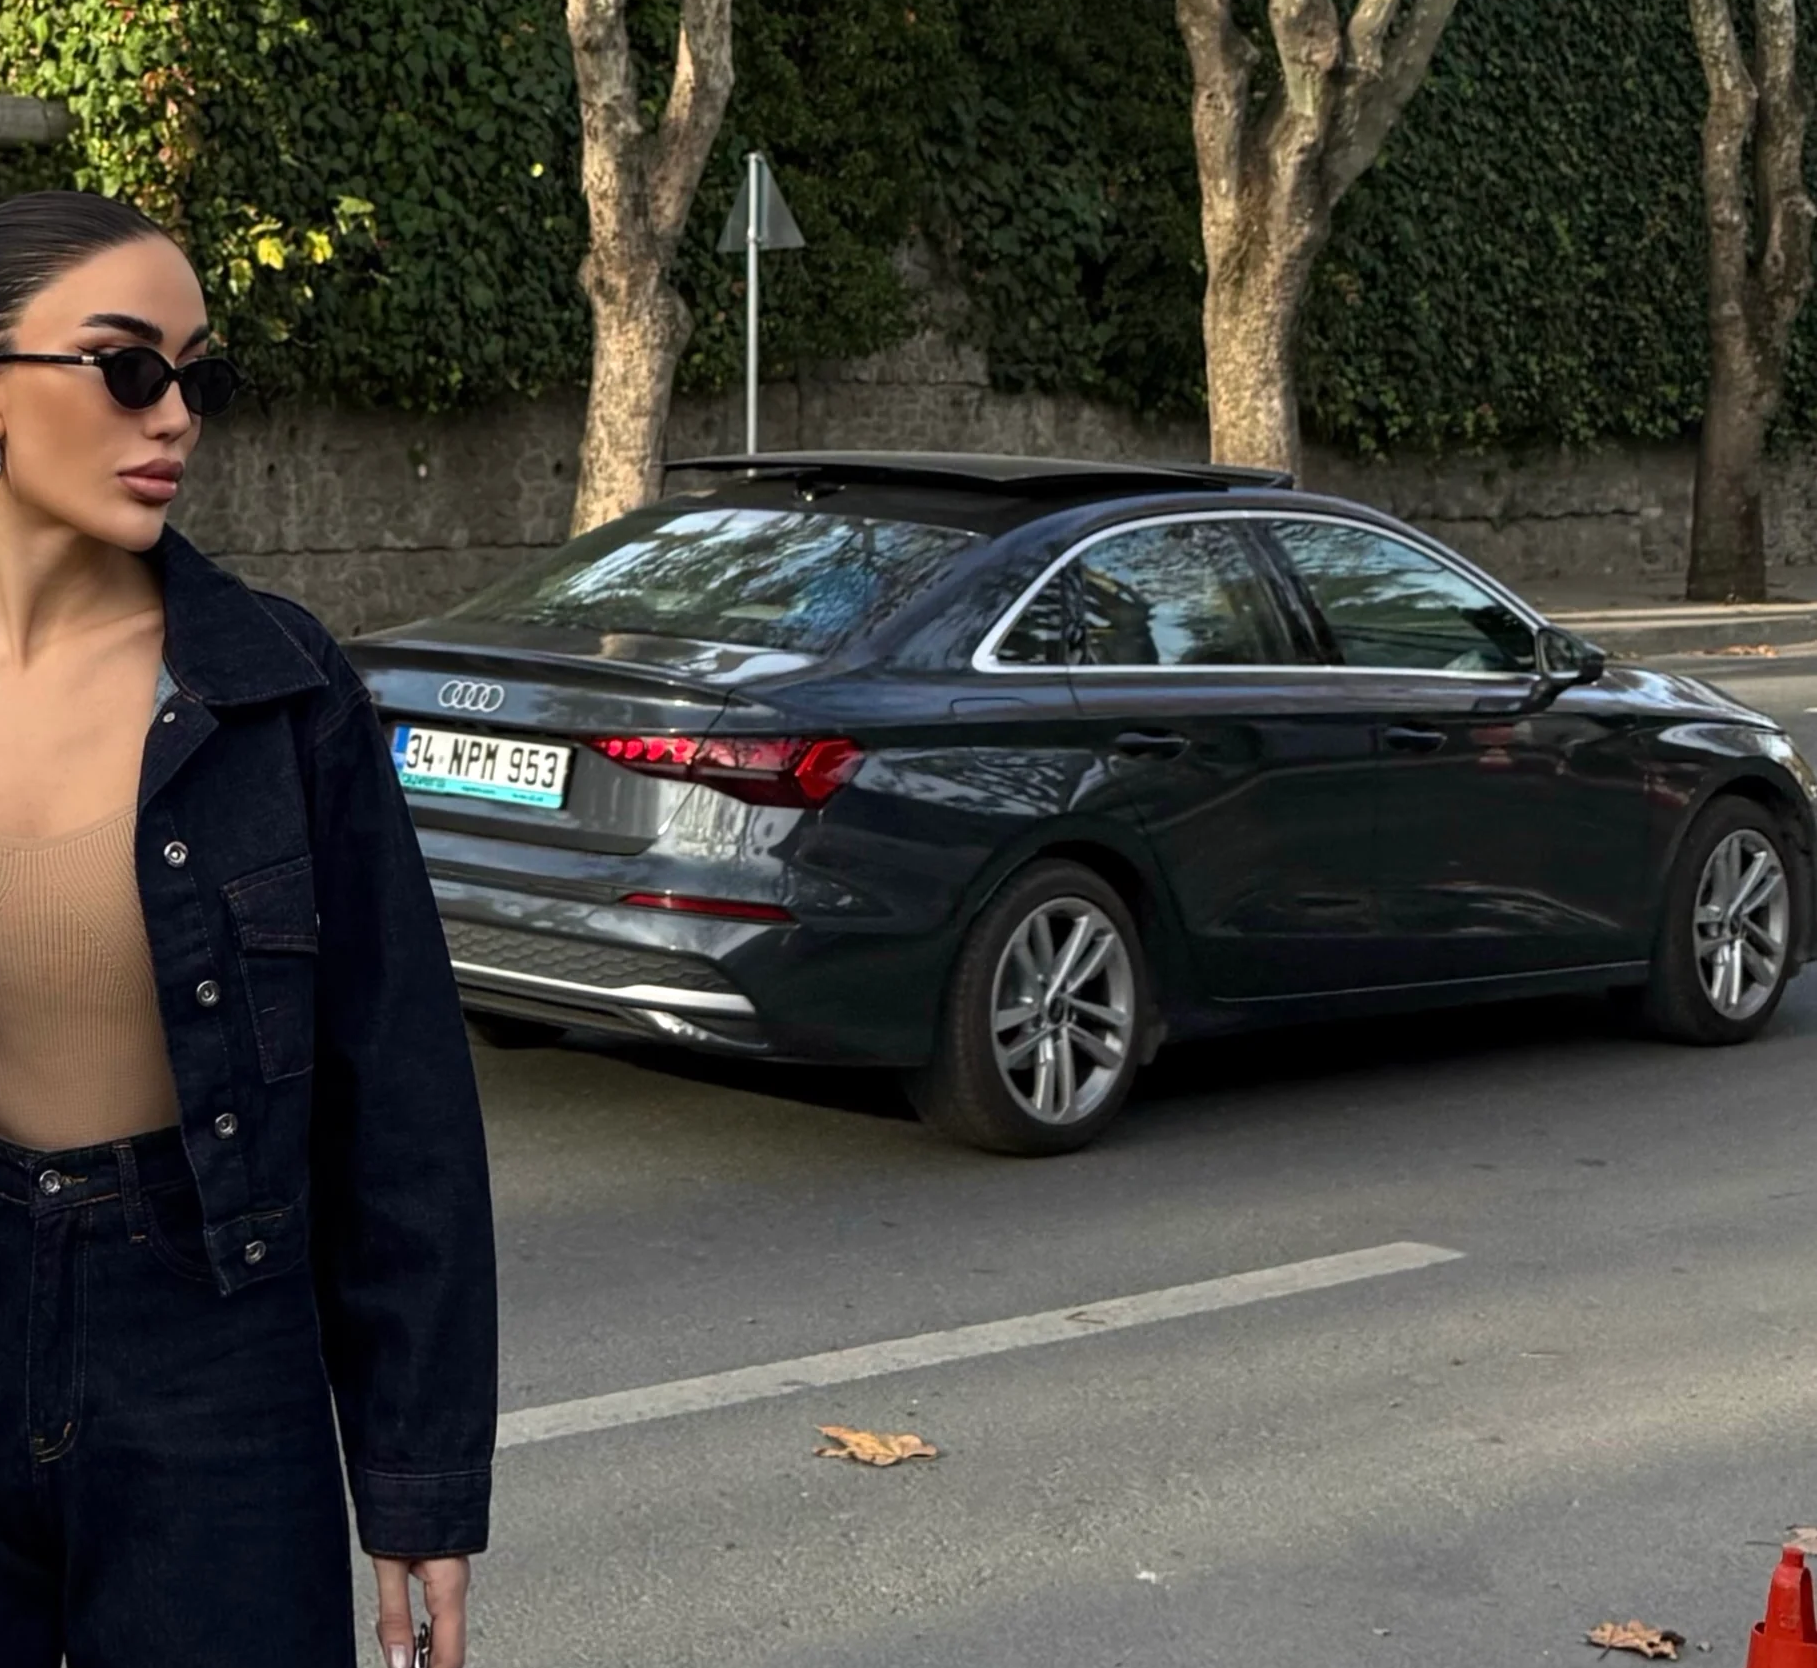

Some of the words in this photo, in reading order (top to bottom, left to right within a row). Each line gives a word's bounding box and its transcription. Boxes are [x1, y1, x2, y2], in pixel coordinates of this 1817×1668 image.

[406, 734, 434, 772] 34
[448, 738, 499, 781] NPM
[508, 747, 558, 788] 953
